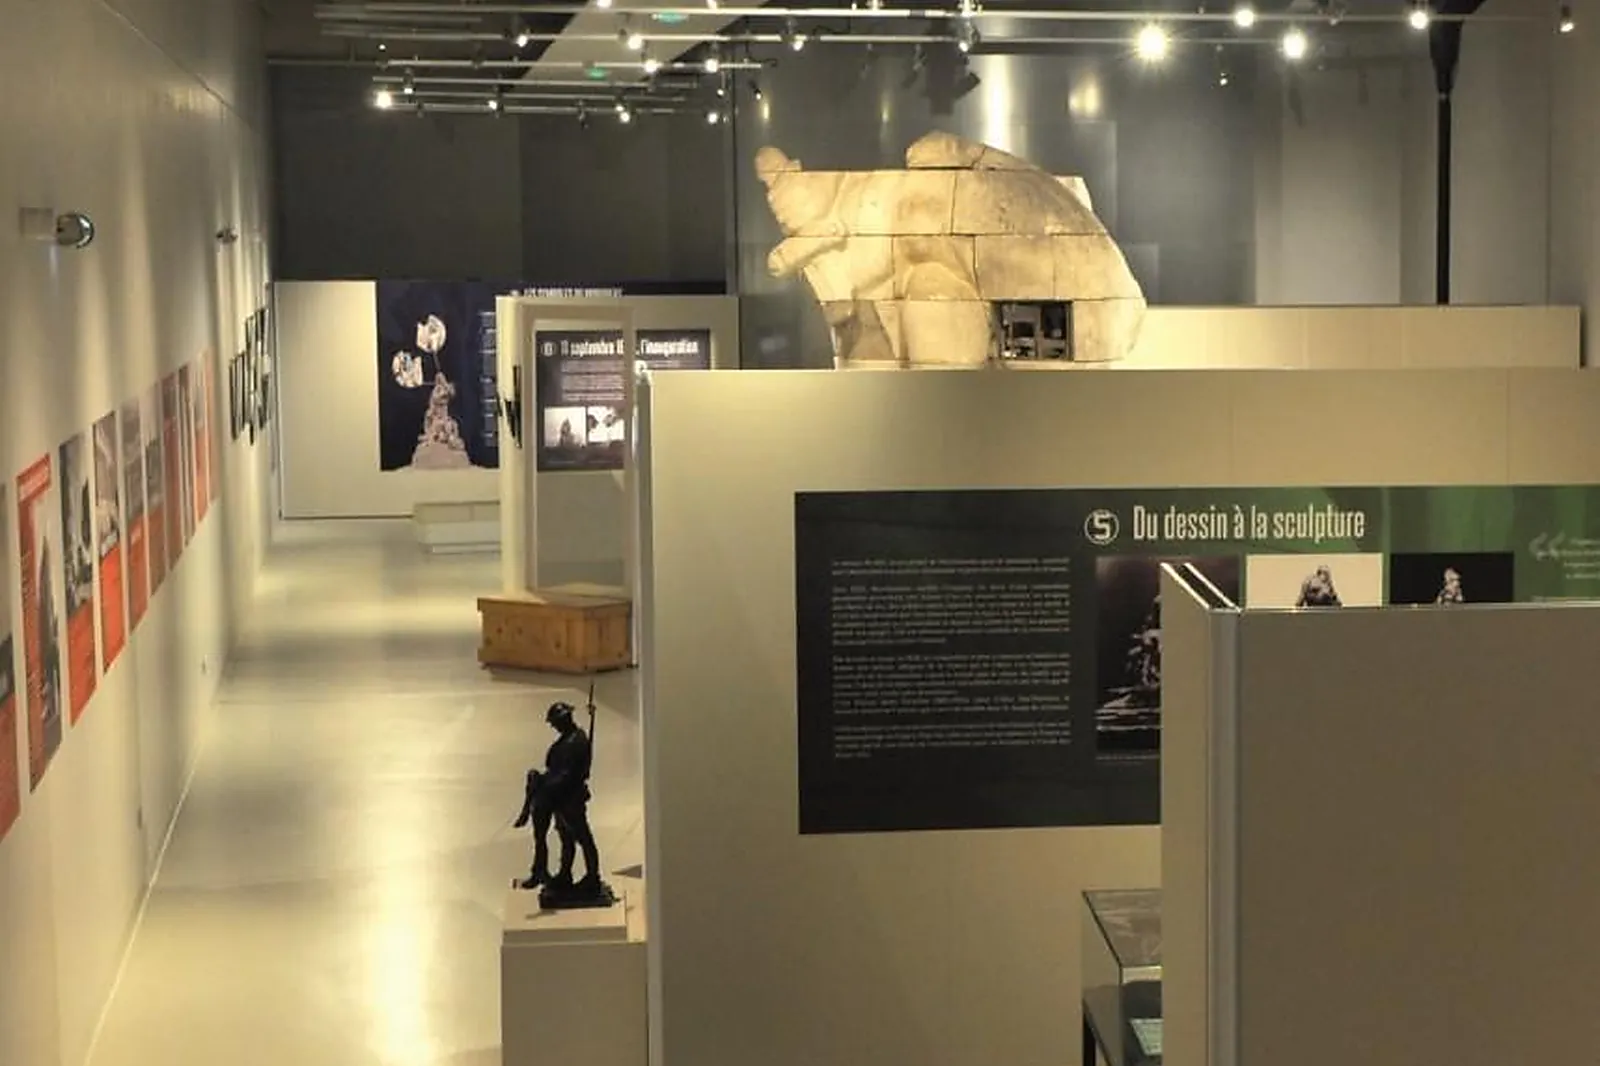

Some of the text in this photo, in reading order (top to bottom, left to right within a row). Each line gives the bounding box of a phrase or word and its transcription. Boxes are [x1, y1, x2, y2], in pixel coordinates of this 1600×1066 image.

[571, 337, 615, 359] septembre
[1133, 504, 1158, 540] Du
[1164, 504, 1228, 540] dessin
[1233, 504, 1245, 540] à
[1250, 504, 1268, 540] la
[1272, 503, 1366, 544] sculpture
